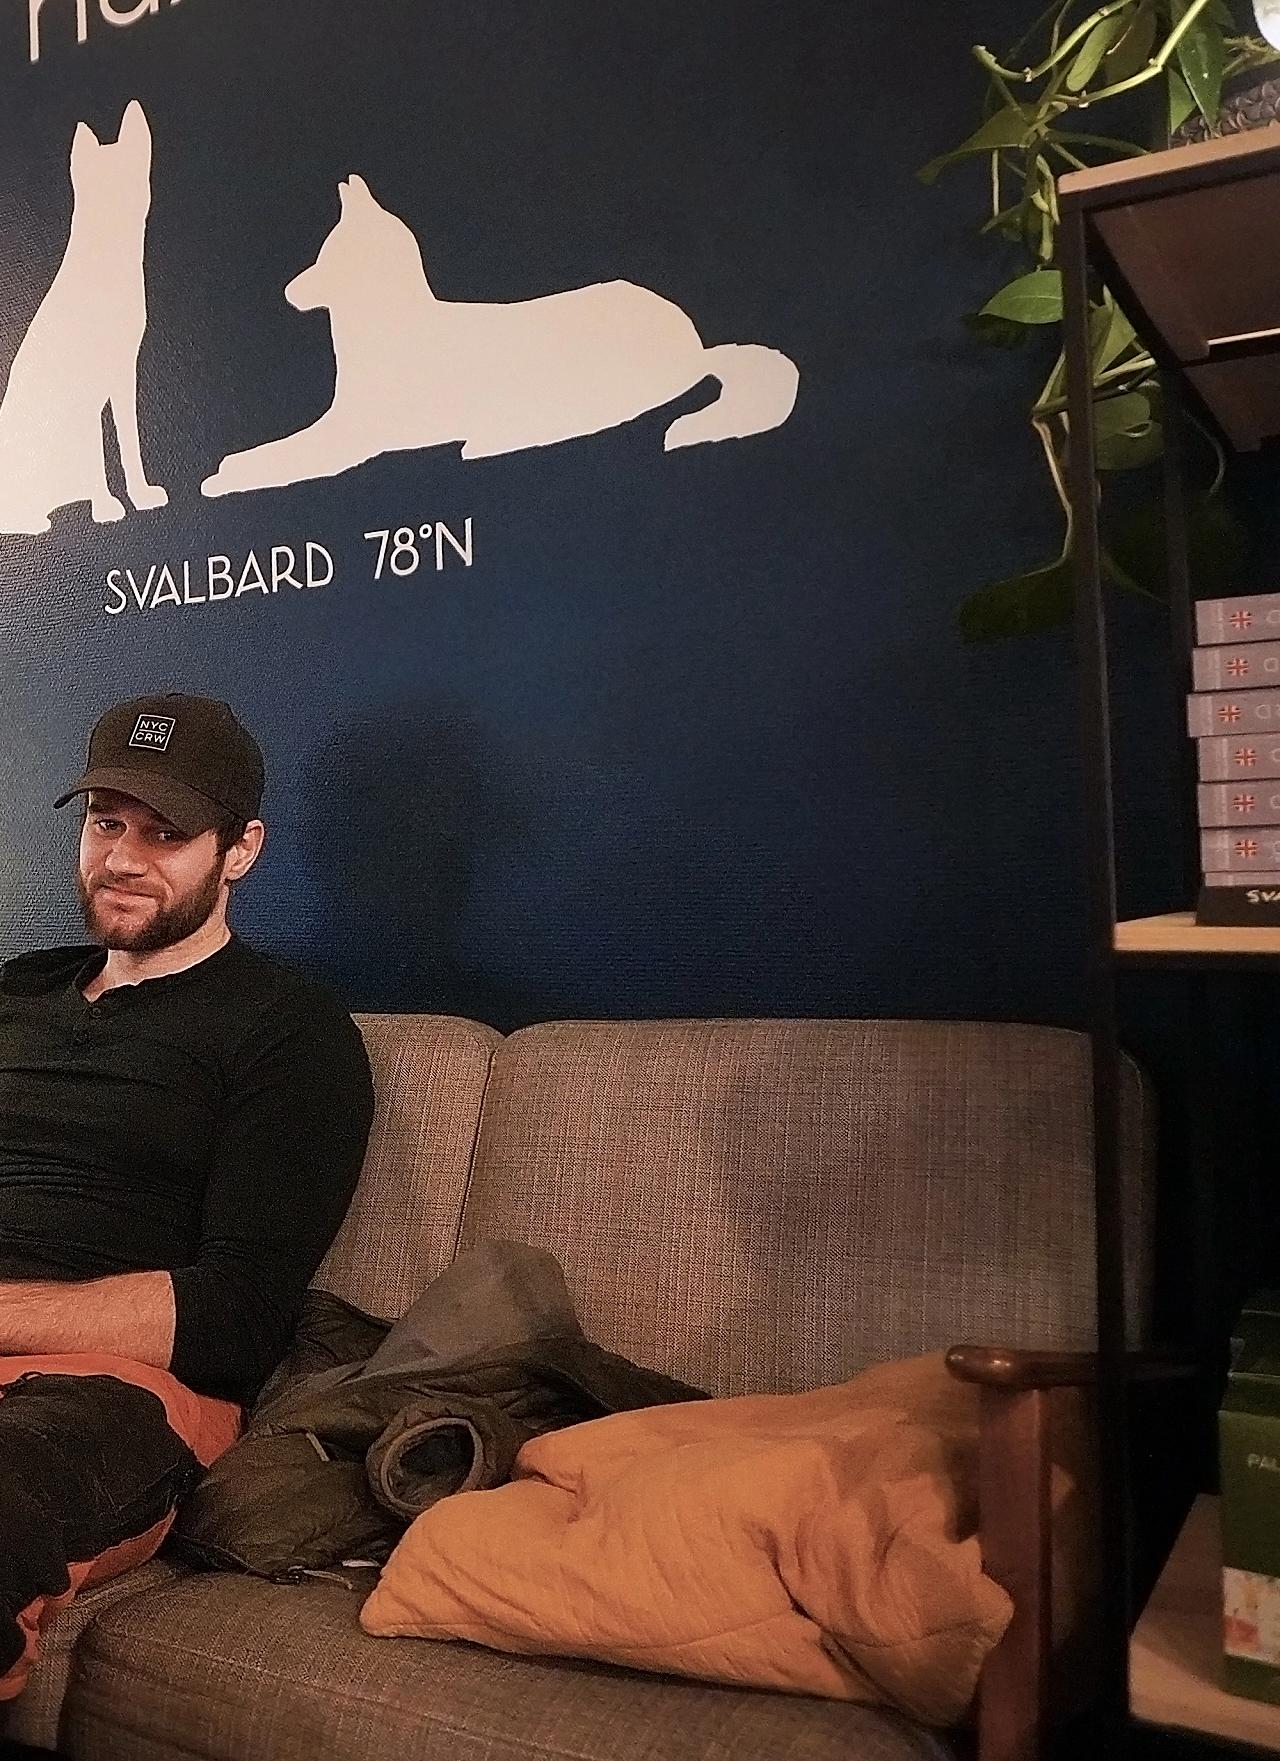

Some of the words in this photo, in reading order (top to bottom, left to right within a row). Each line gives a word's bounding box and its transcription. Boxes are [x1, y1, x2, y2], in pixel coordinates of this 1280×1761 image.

[104, 541, 334, 615] SVALBARD
[363, 517, 473, 580] 78°N
[139, 720, 168, 732] NYC
[135, 731, 167, 744] CRW
